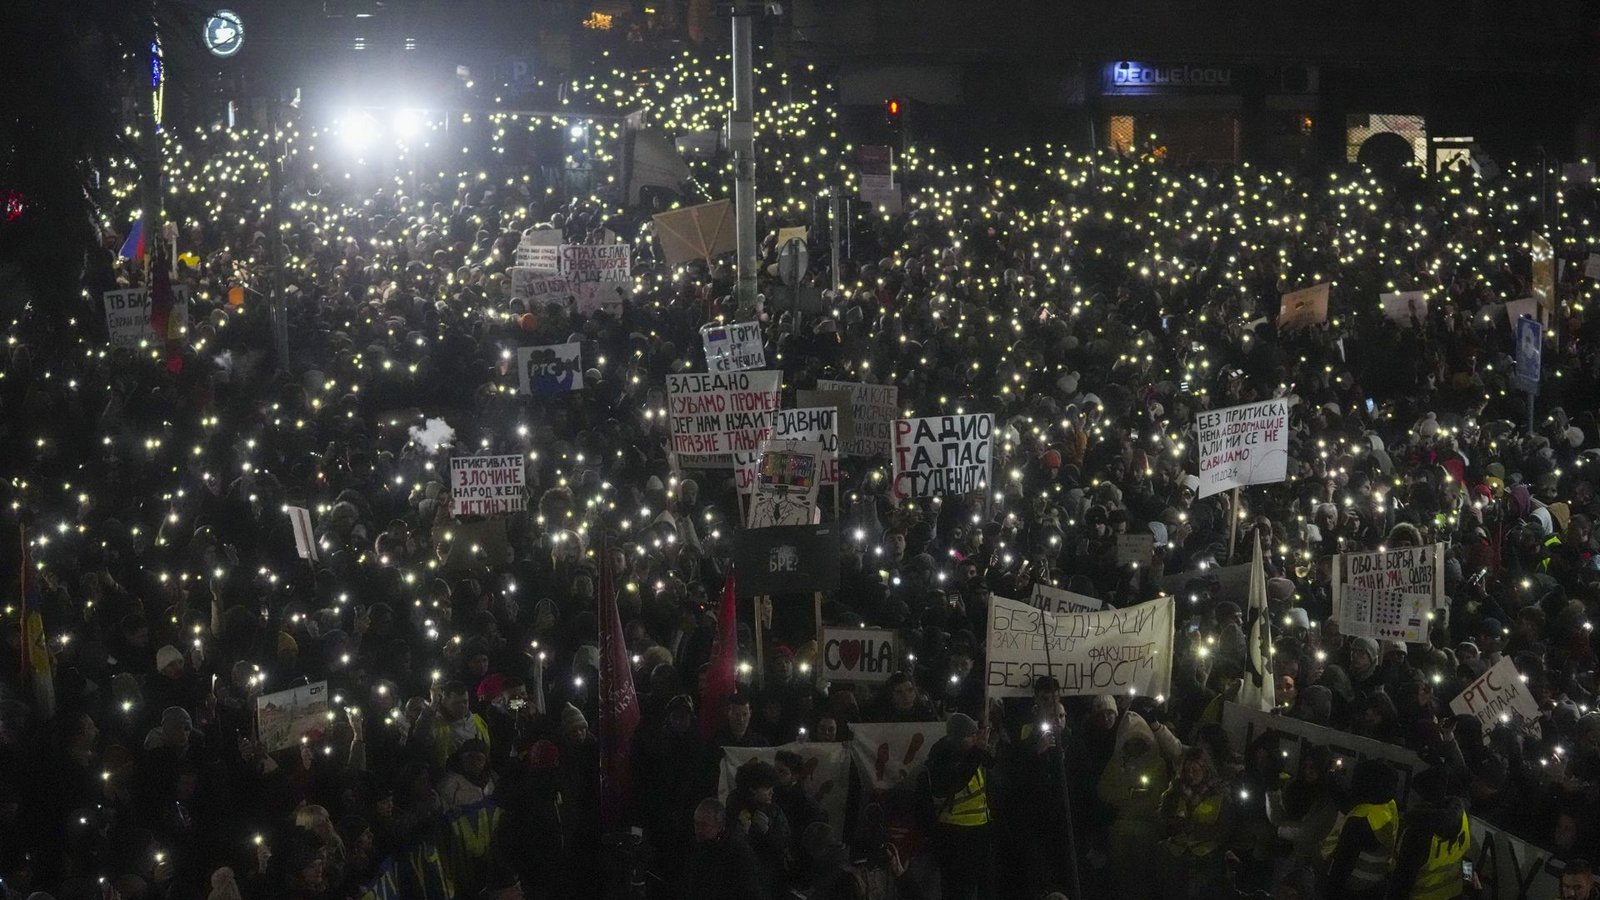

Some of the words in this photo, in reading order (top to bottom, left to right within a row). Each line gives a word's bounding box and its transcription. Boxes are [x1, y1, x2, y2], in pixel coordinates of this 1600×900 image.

[563, 247, 597, 259] СТРАХ
[598, 248, 607, 259] СЕ
[107, 294, 125, 309] ТВ
[730, 325, 760, 343] ГОРИ
[530, 363, 557, 377] РТС
[717, 359, 730, 371] СЕ
[670, 374, 749, 393] ЗАЈЕДНО
[670, 395, 726, 414] КУВАМО
[672, 416, 693, 434] ЈЕР
[696, 414, 721, 433] НАМ
[726, 410, 778, 430] НУДИТЕ
[1198, 413, 1221, 430] БЕЗ
[1226, 403, 1285, 423] ПРИТИСКА
[896, 414, 991, 445] РАДИО
[1200, 430, 1220, 443] НЕМА
[1221, 417, 1285, 436] ДЕФОРМАЦИЈЕ
[674, 433, 720, 453] ПРАЗНЕ
[1201, 439, 1223, 457] АЛИ
[1226, 434, 1240, 448] МИ
[1245, 431, 1258, 445] СЕ
[1264, 430, 1279, 442] НЕ
[453, 456, 523, 469] ПРИКРИВАТЕ
[896, 441, 988, 470] ТАЛАС
[1200, 448, 1250, 471] САВИЈАМО
[459, 468, 521, 486] ЗЛОЧИНЕ
[894, 465, 988, 499] СТУДЕНАТА
[453, 486, 492, 498] НАРОД
[495, 485, 525, 497] ЖЕЛИ
[1352, 555, 1371, 575] ОВО
[1372, 553, 1383, 570] ЈЕ
[1386, 550, 1414, 569] БОРБА
[1409, 565, 1432, 584] ОДРАЗ
[993, 605, 1156, 639] БЕЗБЕДЊАЦИ
[994, 631, 1077, 652] ЗАХТЕВАЈУ
[1088, 642, 1156, 661] ФАКУЛТЕТ
[1463, 671, 1502, 714] РТС
